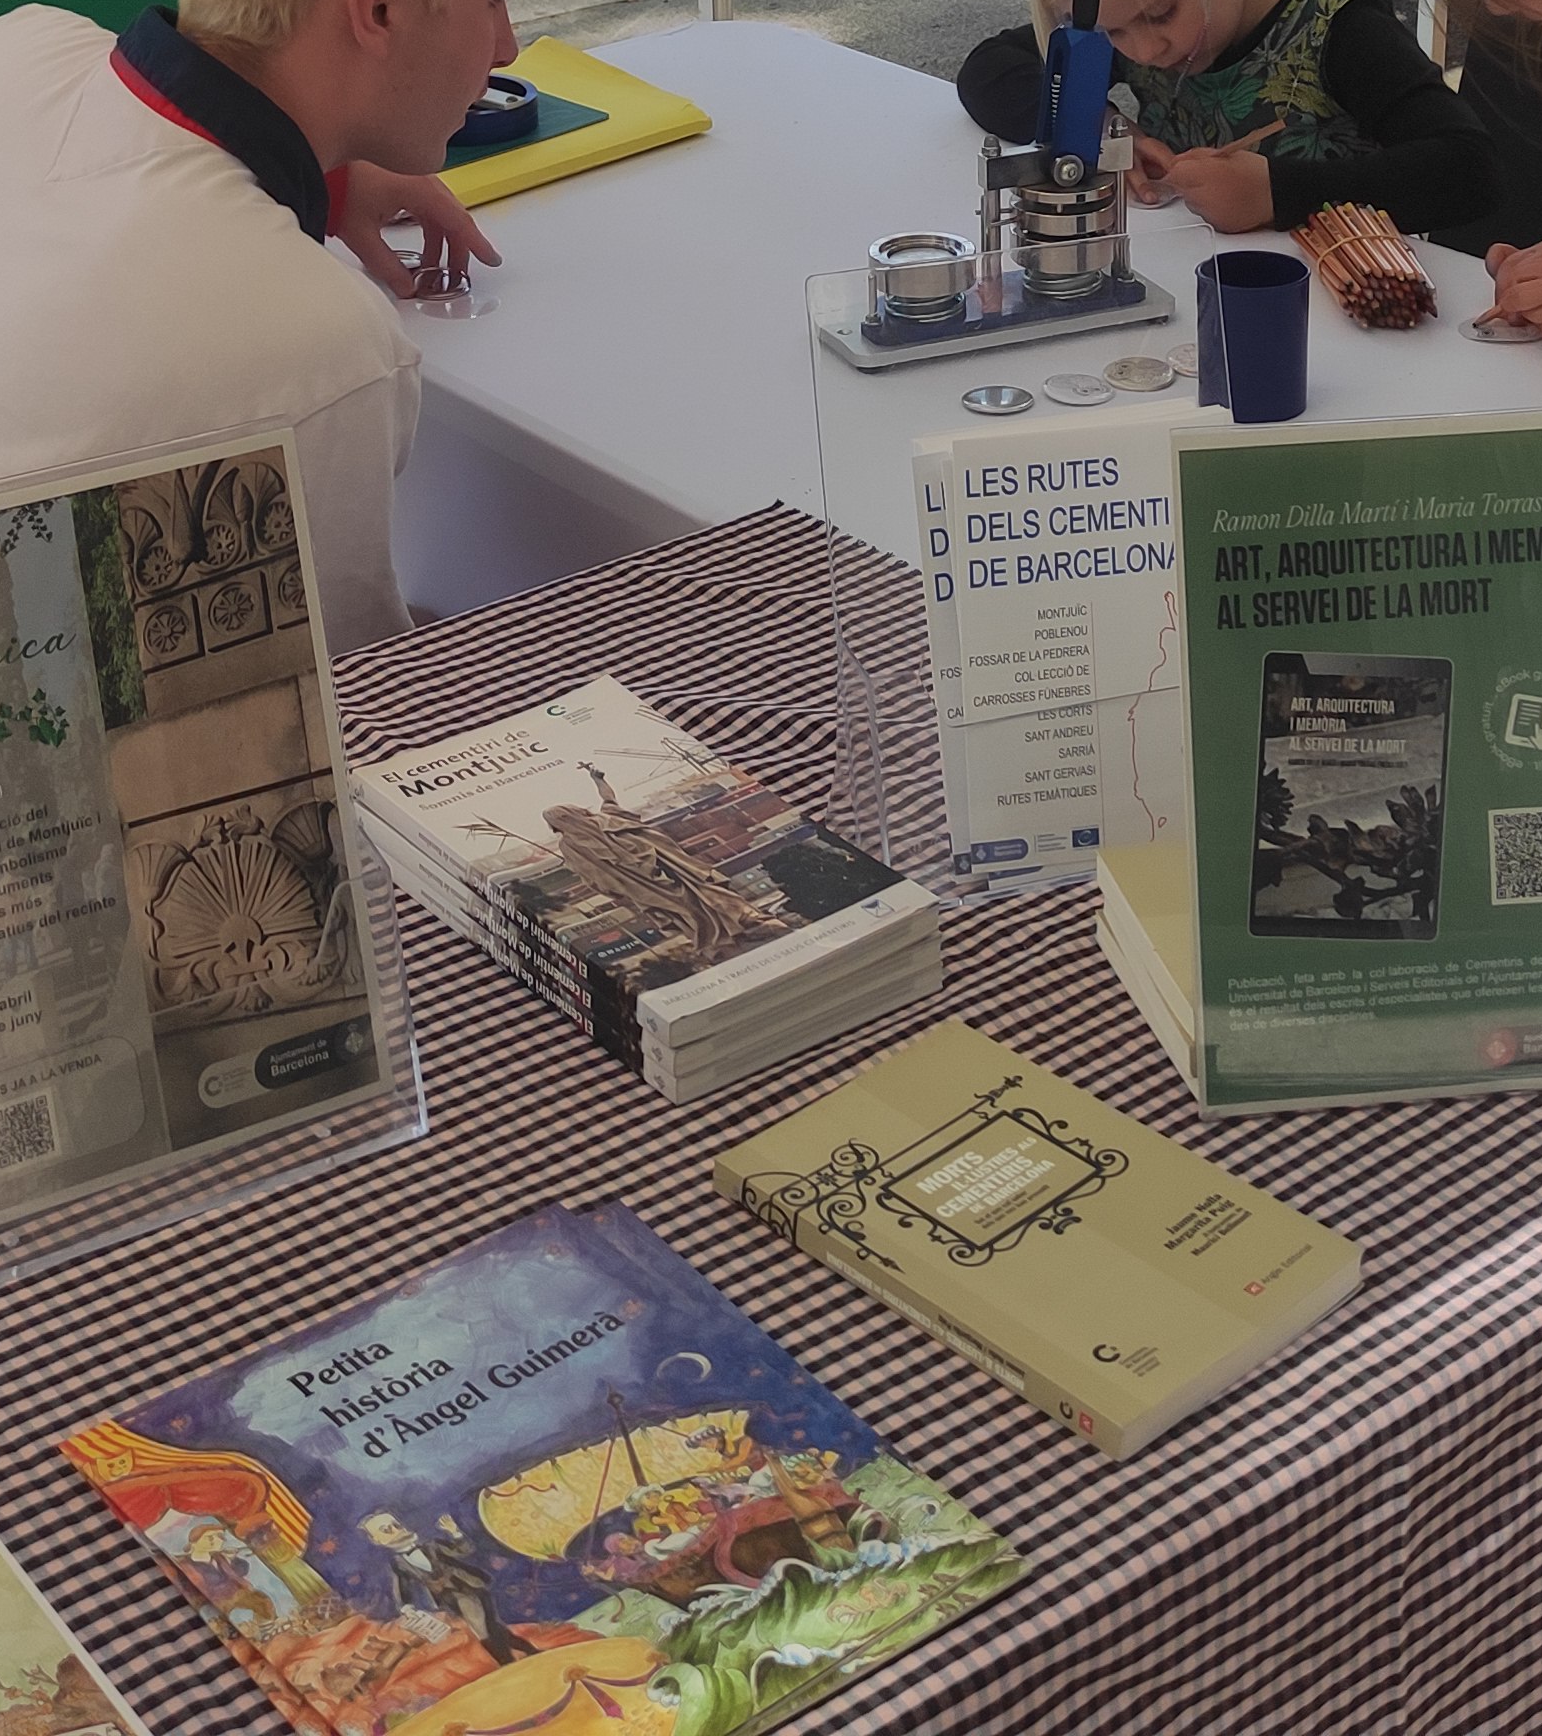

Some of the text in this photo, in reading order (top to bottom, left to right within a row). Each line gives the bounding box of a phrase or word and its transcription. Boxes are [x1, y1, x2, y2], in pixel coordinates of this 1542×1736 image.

[965, 457, 1119, 499] LES RUTES
[967, 497, 1170, 544] DELS CEMENTI
[1212, 509, 1281, 534] Ramon
[1285, 504, 1335, 529] Dilla
[1339, 499, 1400, 525] Martí
[1413, 494, 1476, 521] Maria
[1481, 491, 1542, 517] Torras
[969, 557, 1008, 589] DE
[1215, 544, 1271, 584] ART,
[1277, 530, 1468, 580] ARQUITECTURA
[1037, 604, 1087, 620] MONTJUÏC
[1217, 577, 1492, 630] AL SERVEI DE LA MORT
[1034, 625, 1088, 640] POBLENOU
[969, 645, 1090, 668] FOSSAR DE LA PEDRERA
[1076, 665, 1090, 677] DE
[973, 684, 1091, 707] CARROSSES FÚNEBRES
[1037, 704, 1093, 721] LES CORTS
[1316, 696, 1395, 715] ARQUITECTURA
[1024, 725, 1094, 743] SANT ANDREU
[1296, 714, 1347, 733] MEMÒRIA
[381, 727, 530, 784] El cementiri de
[1289, 738, 1407, 754] AL SERVEI DE LA MORT
[397, 740, 549, 799] Montjuïc
[418, 757, 566, 812] Somnis de Barcelona
[1024, 765, 1096, 783] SANT GERVASI
[997, 783, 1097, 807] RUTES TEMÀTIQUES
[26, 804, 49, 822] del
[6, 834, 25, 849] de
[28, 815, 94, 846] Montjuïc
[11, 894, 43, 915] més
[38, 908, 62, 929] del
[65, 895, 117, 921] recinte
[11, 1076, 27, 1094] JA
[29, 1073, 39, 1088] A
[41, 1066, 57, 1082] LA
[58, 1052, 103, 1079] VENDA
[270, 1049, 330, 1077] Barcelona
[1018, 1136, 1038, 1152] ALS
[916, 1151, 984, 1195] MORTS
[936, 1155, 1033, 1218] CEMENTIRIS
[969, 1202, 986, 1215] DE
[983, 1159, 1056, 1207] BARCELONA
[1165, 1212, 1198, 1235] Jaume
[1195, 1193, 1223, 1213] Nolla
[1163, 1217, 1212, 1251] Margarita
[486, 1310, 626, 1390] Guimerà
[287, 1340, 395, 1399] Petita
[318, 1357, 455, 1430] història
